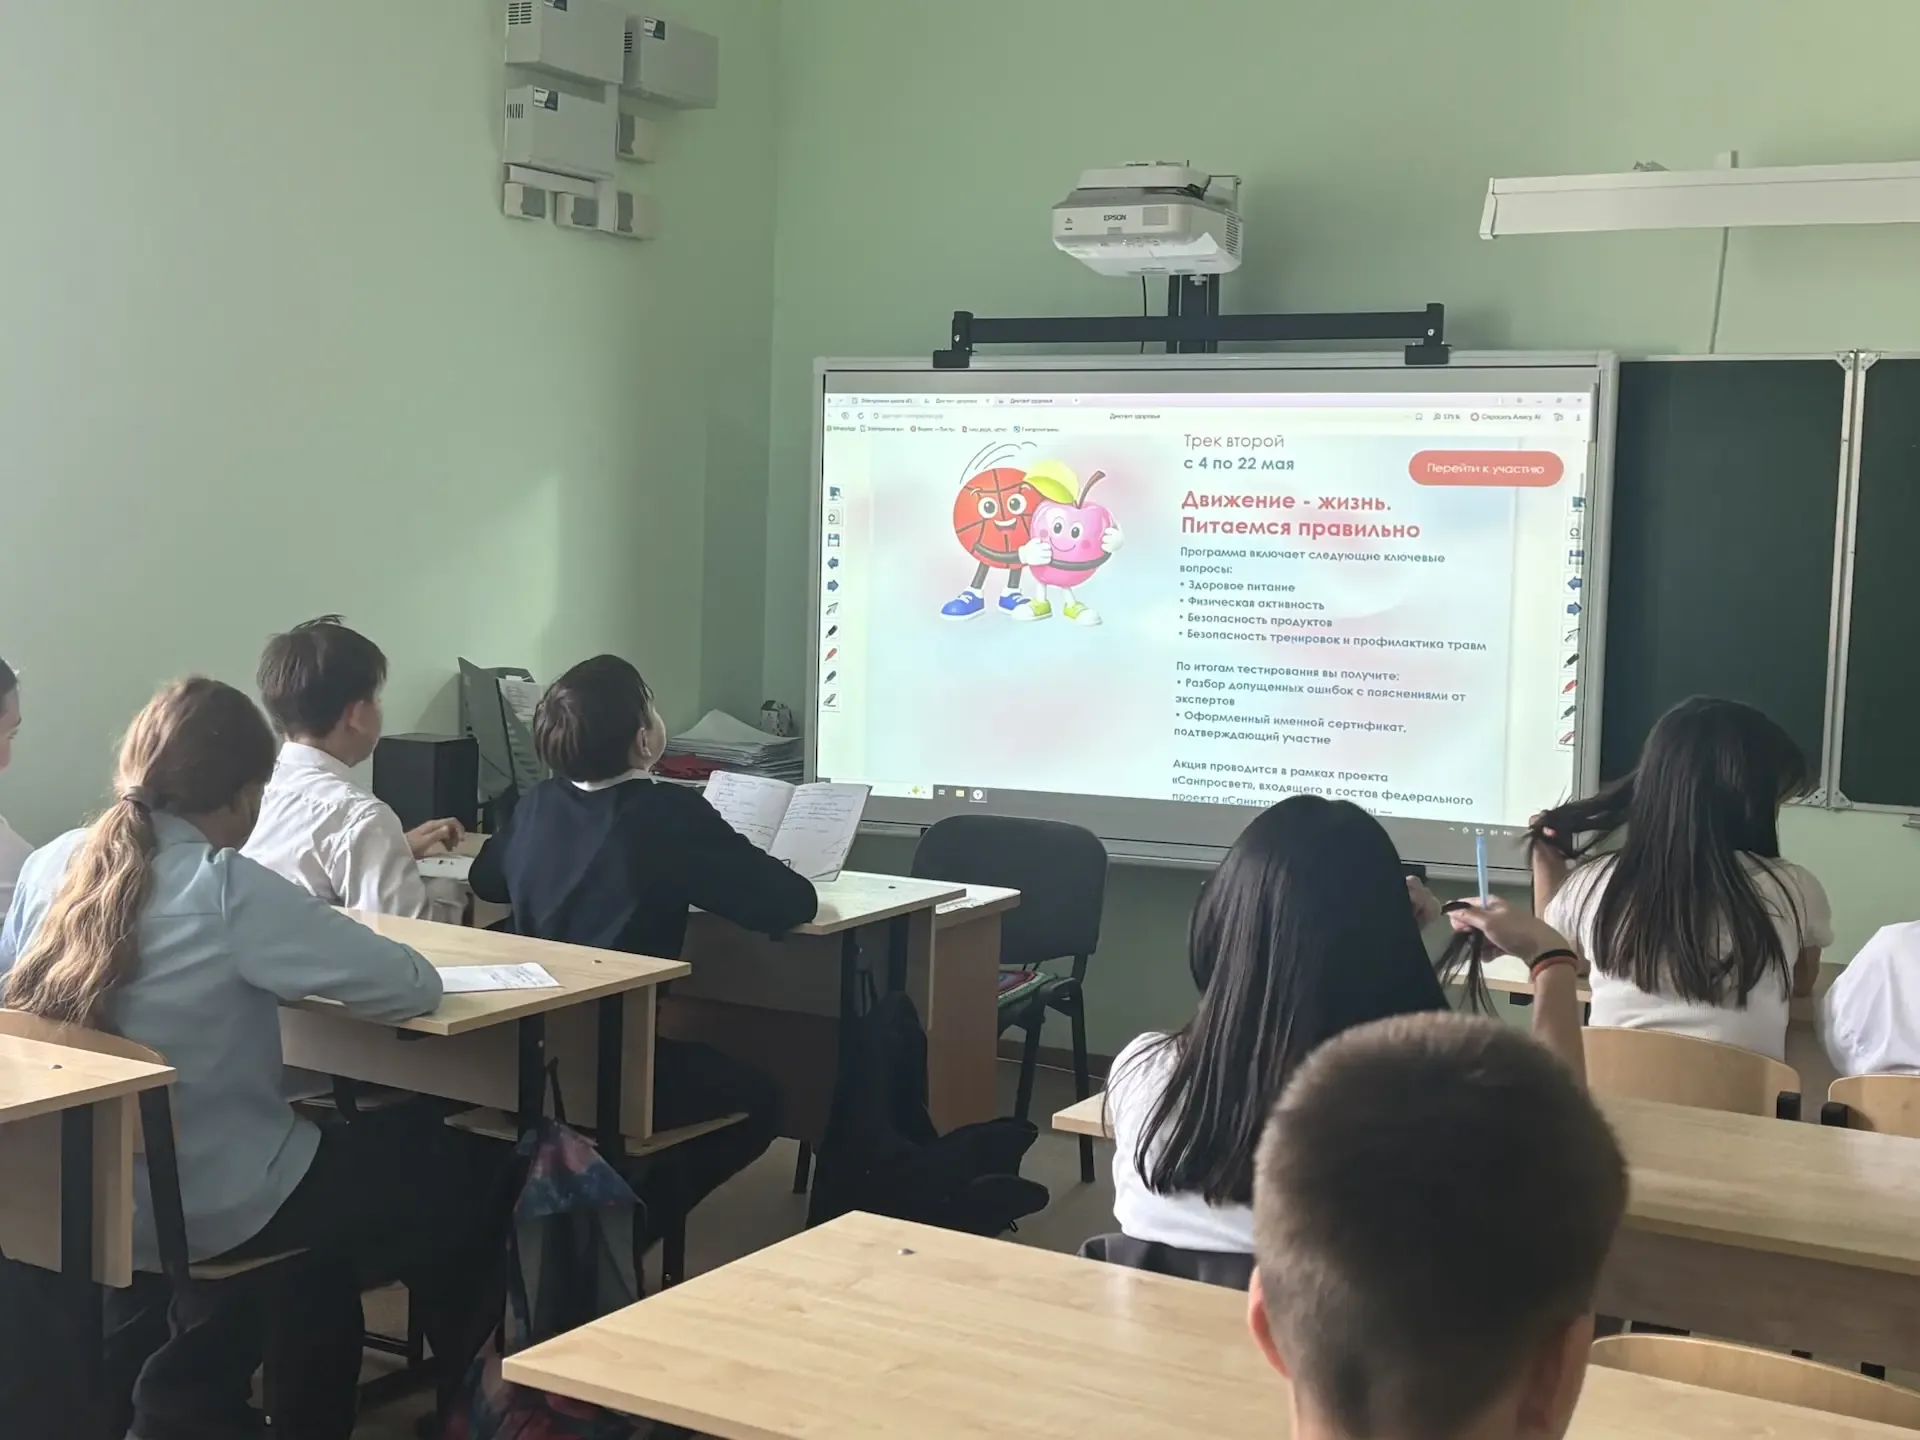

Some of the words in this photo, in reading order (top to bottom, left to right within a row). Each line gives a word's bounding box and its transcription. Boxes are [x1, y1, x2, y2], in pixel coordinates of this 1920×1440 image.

[1103, 214, 1126, 222] EPSON
[1183, 434, 1223, 450] Трек
[1226, 434, 1284, 450] второй
[1198, 457, 1208, 469] 4
[1212, 459, 1233, 470] по
[1238, 458, 1257, 470] 22
[1261, 459, 1295, 471] мая
[1427, 463, 1480, 474] Перейти
[1492, 466, 1545, 475] участию
[1181, 491, 1296, 510] Движение
[1317, 496, 1392, 511] жизнь.
[1181, 517, 1291, 536] Питаемся
[1298, 521, 1421, 540] правильно
[1180, 547, 1247, 559] Программа
[1249, 549, 1306, 560] включает
[1308, 550, 1381, 562] следующие
[1384, 552, 1446, 563] ключевые
[1179, 564, 1233, 575] вопросы:
[1188, 580, 1244, 592] Здоровое
[1247, 582, 1296, 593] питание
[1188, 596, 1255, 608] Физическая
[1258, 600, 1325, 610] активность
[1187, 613, 1267, 625] Безопасность
[1270, 616, 1333, 628] продуктов
[1186, 629, 1267, 641] Безопасность
[1270, 633, 1341, 645] тренировок
[1353, 636, 1444, 649] профилактика
[1447, 640, 1487, 651] травм
[1176, 662, 1191, 671] По
[1194, 663, 1234, 673] итогам
[1237, 665, 1320, 677] тестирования
[1322, 669, 1338, 678] вы
[1340, 669, 1400, 681] получите:
[1185, 679, 1225, 691] Разбор
[1228, 681, 1304, 694] допущенных
[1307, 685, 1353, 695] ошибок
[1356, 688, 1364, 696] с
[1367, 688, 1449, 701] пояснениями
[1451, 692, 1466, 702] от
[1175, 695, 1235, 707] экспертов
[1184, 710, 1271, 725] Оформленный
[1273, 716, 1325, 727] именной
[1328, 719, 1407, 734] сертификат,
[1173, 728, 1280, 743] подтверждающий
[1282, 732, 1332, 745] участие
[1172, 759, 1207, 770] Акция
[1210, 763, 1278, 775] проводится
[1281, 768, 1287, 776] в
[1290, 767, 1335, 779] рамках
[1338, 771, 1389, 783] проекта
[1172, 775, 1256, 790] «Санпросвет»,
[1259, 782, 1323, 795] входящего
[1335, 787, 1378, 799] состав
[1381, 789, 1474, 806] федерального
[1172, 792, 1220, 803] проекта
